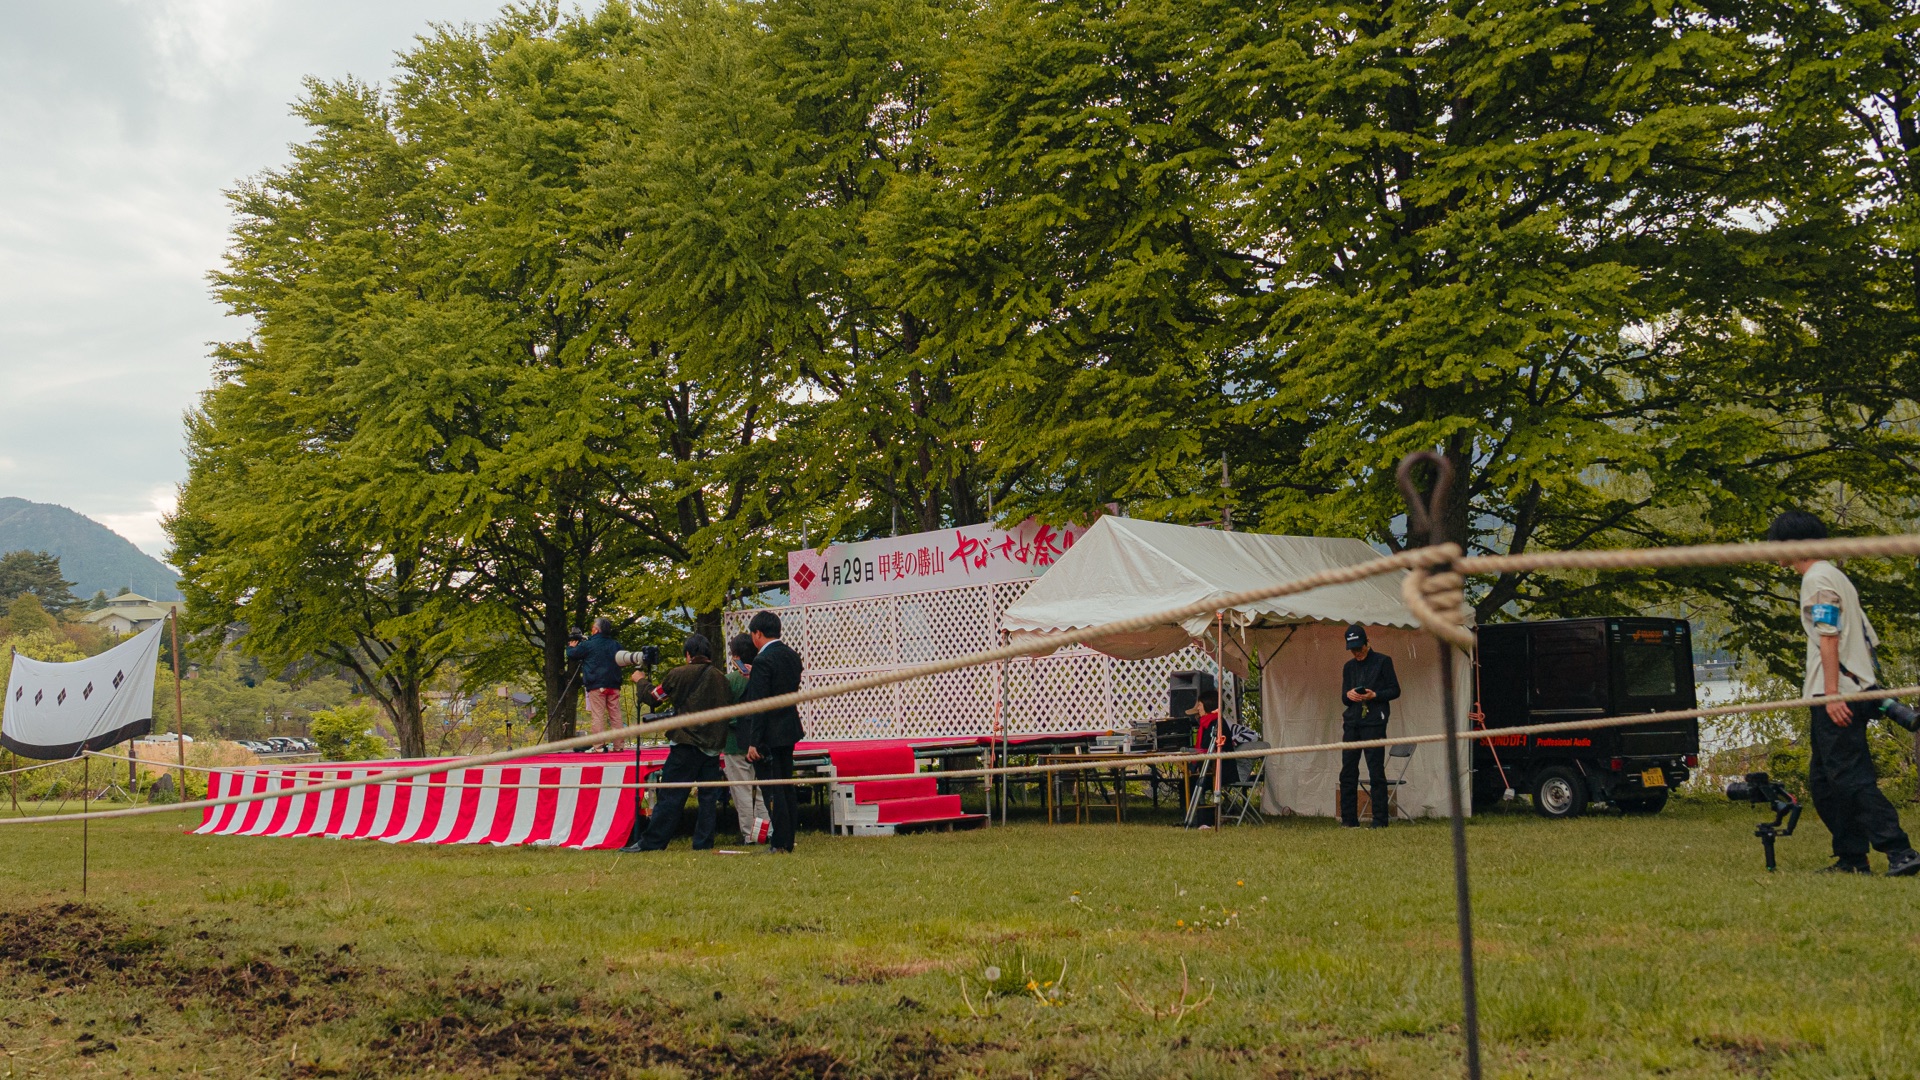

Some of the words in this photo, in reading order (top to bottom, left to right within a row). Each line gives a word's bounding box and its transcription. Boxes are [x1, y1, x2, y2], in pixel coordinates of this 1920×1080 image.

[821, 557, 874, 587] 4月29日
[878, 546, 945, 582] 甲斐の勝山
[1573, 737, 1592, 747] Audio
